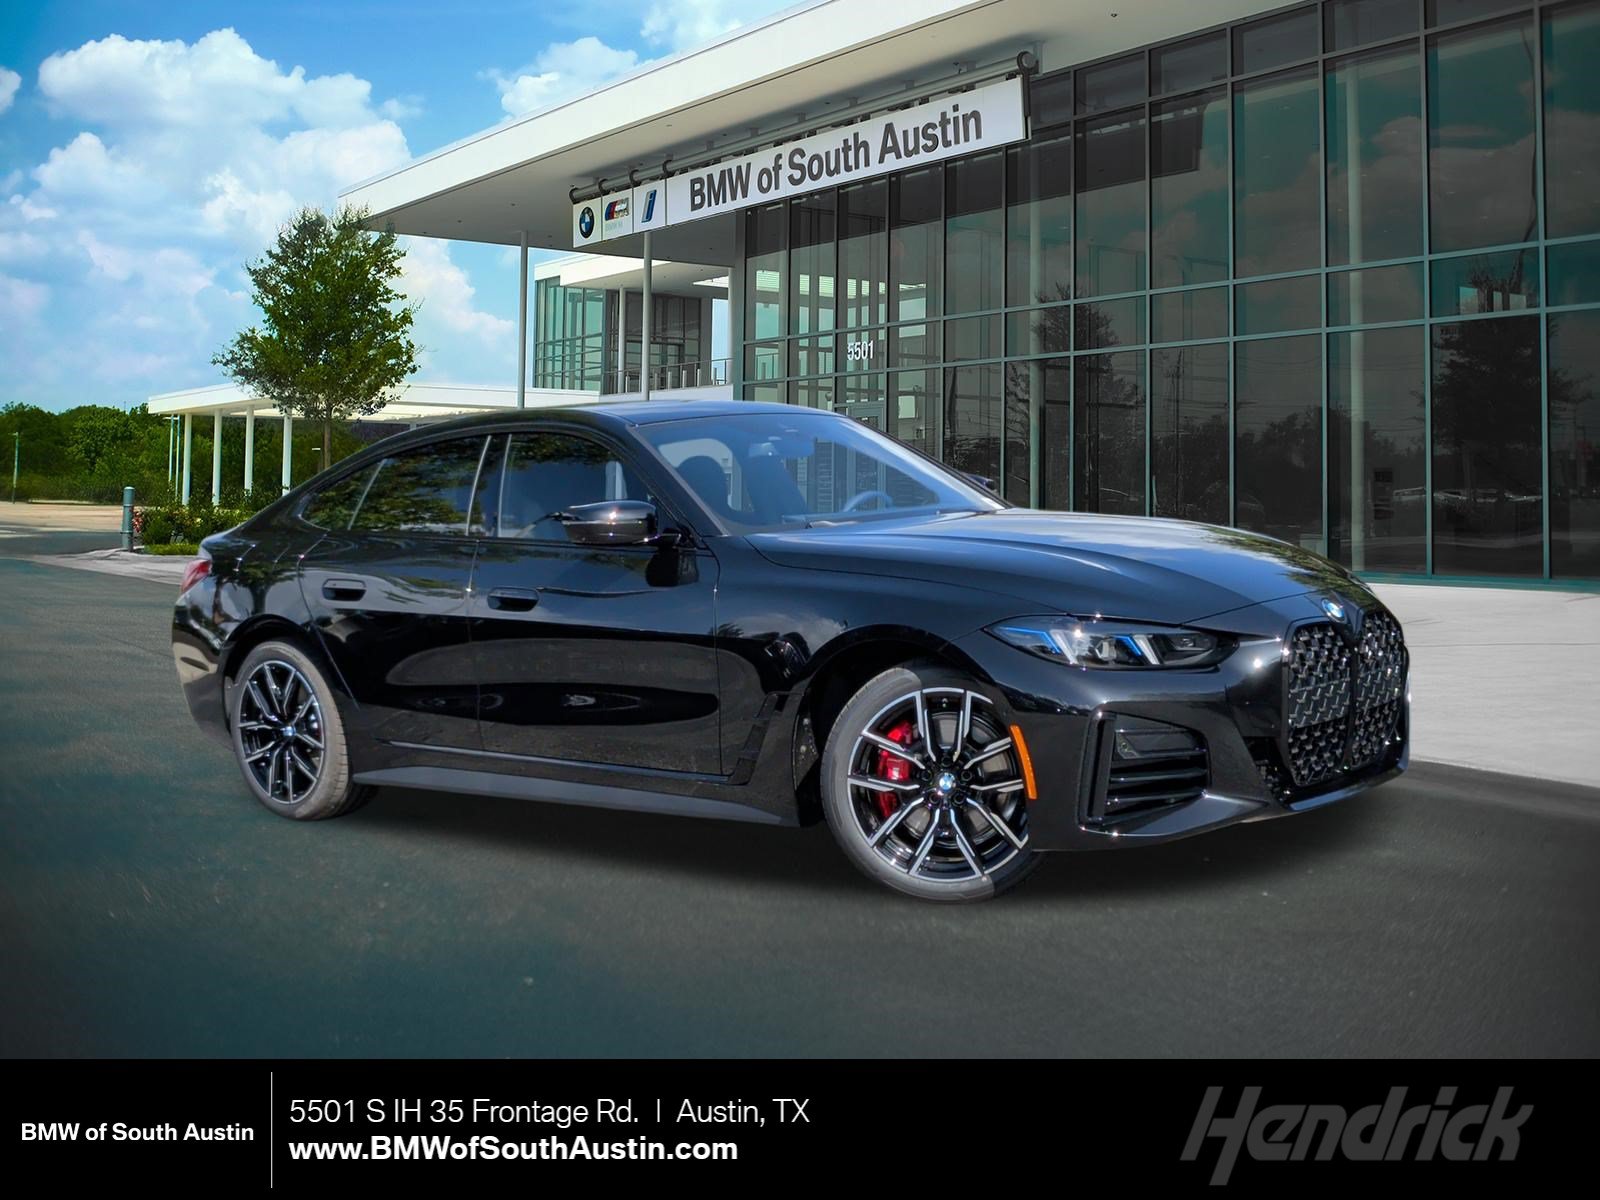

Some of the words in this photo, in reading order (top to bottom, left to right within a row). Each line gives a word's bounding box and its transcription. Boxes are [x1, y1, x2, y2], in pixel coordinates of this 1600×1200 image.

[689, 162, 752, 212] BMW
[757, 153, 783, 194] of
[787, 131, 870, 187] South
[878, 104, 983, 164] Austin
[847, 340, 874, 361] 5501
